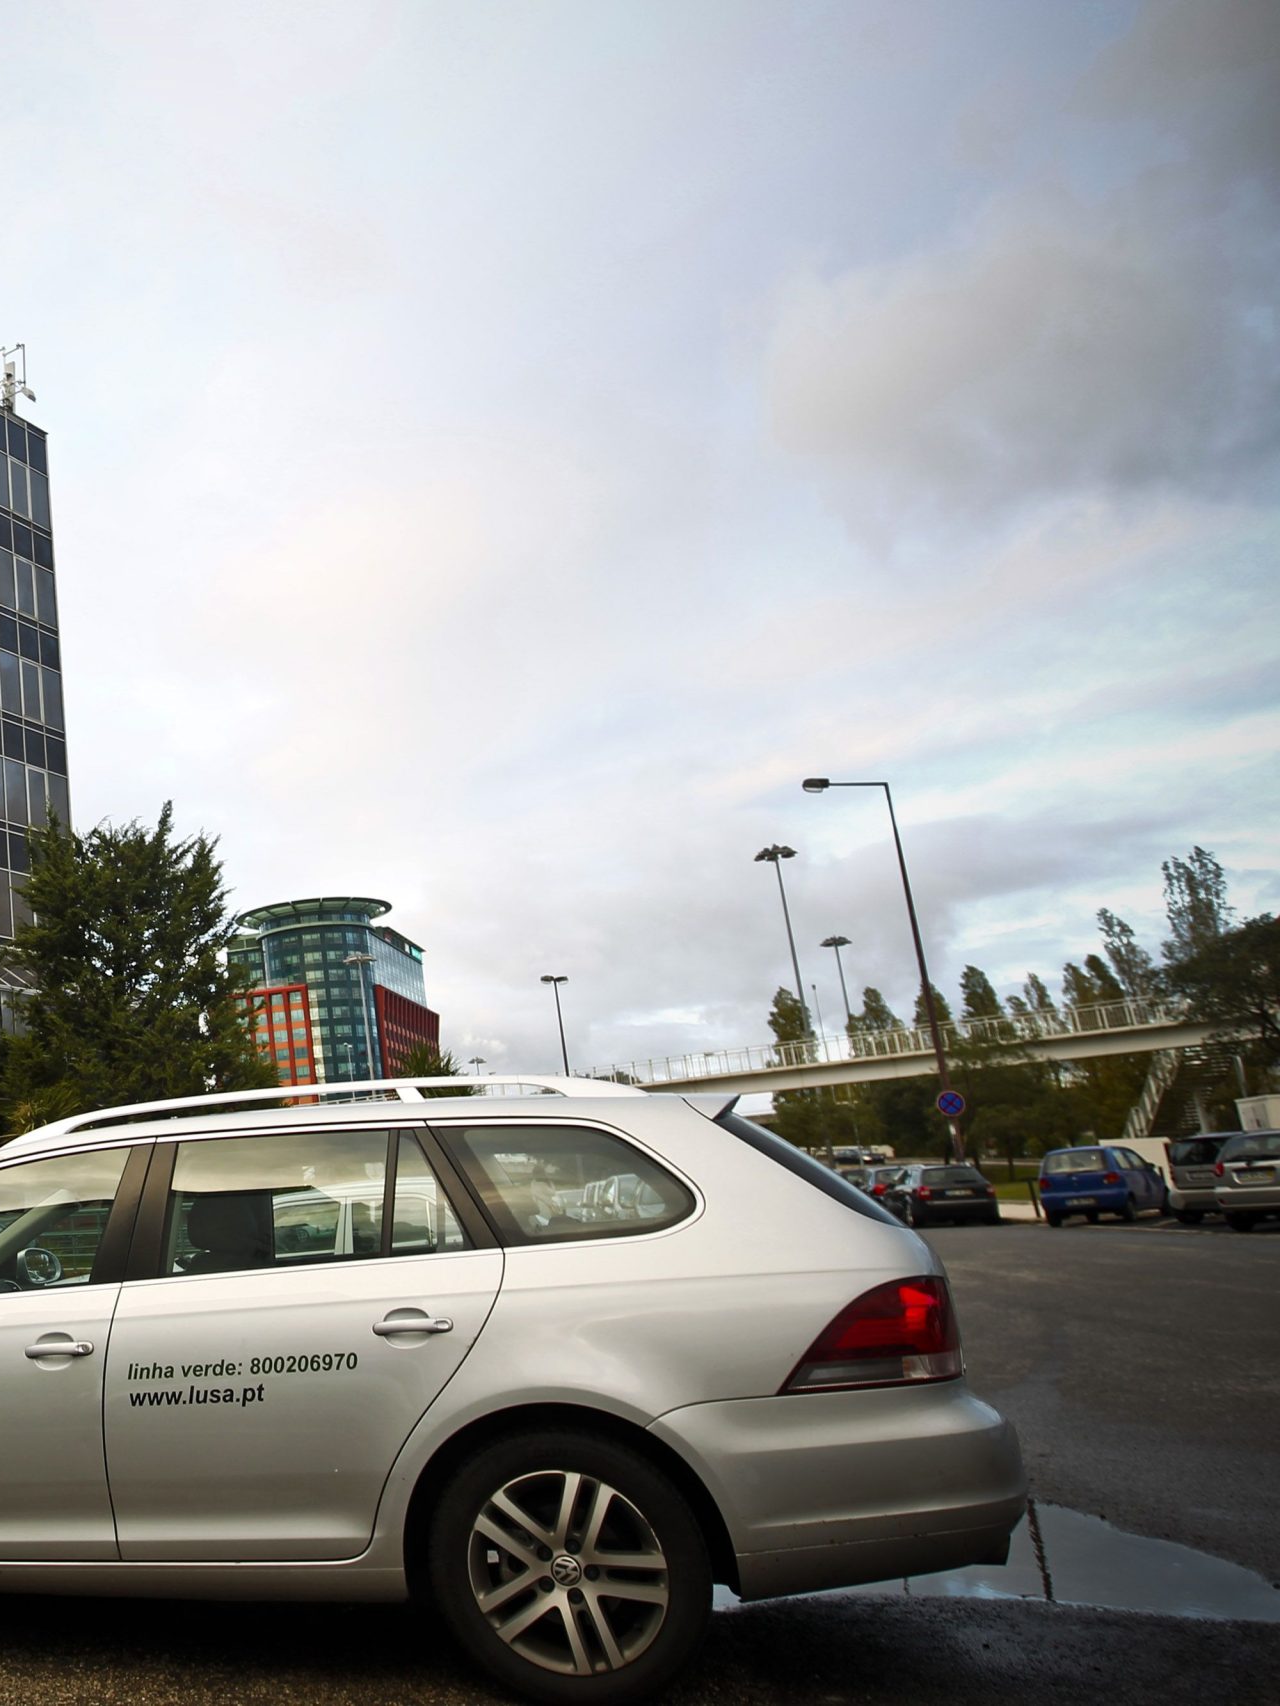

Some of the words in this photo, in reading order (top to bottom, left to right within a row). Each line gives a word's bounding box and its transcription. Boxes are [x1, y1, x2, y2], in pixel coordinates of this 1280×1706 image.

[127, 1363, 175, 1381] linha
[181, 1359, 243, 1378] verde:
[249, 1352, 359, 1375] 800206970
[129, 1383, 266, 1408] www.lusa.pt
